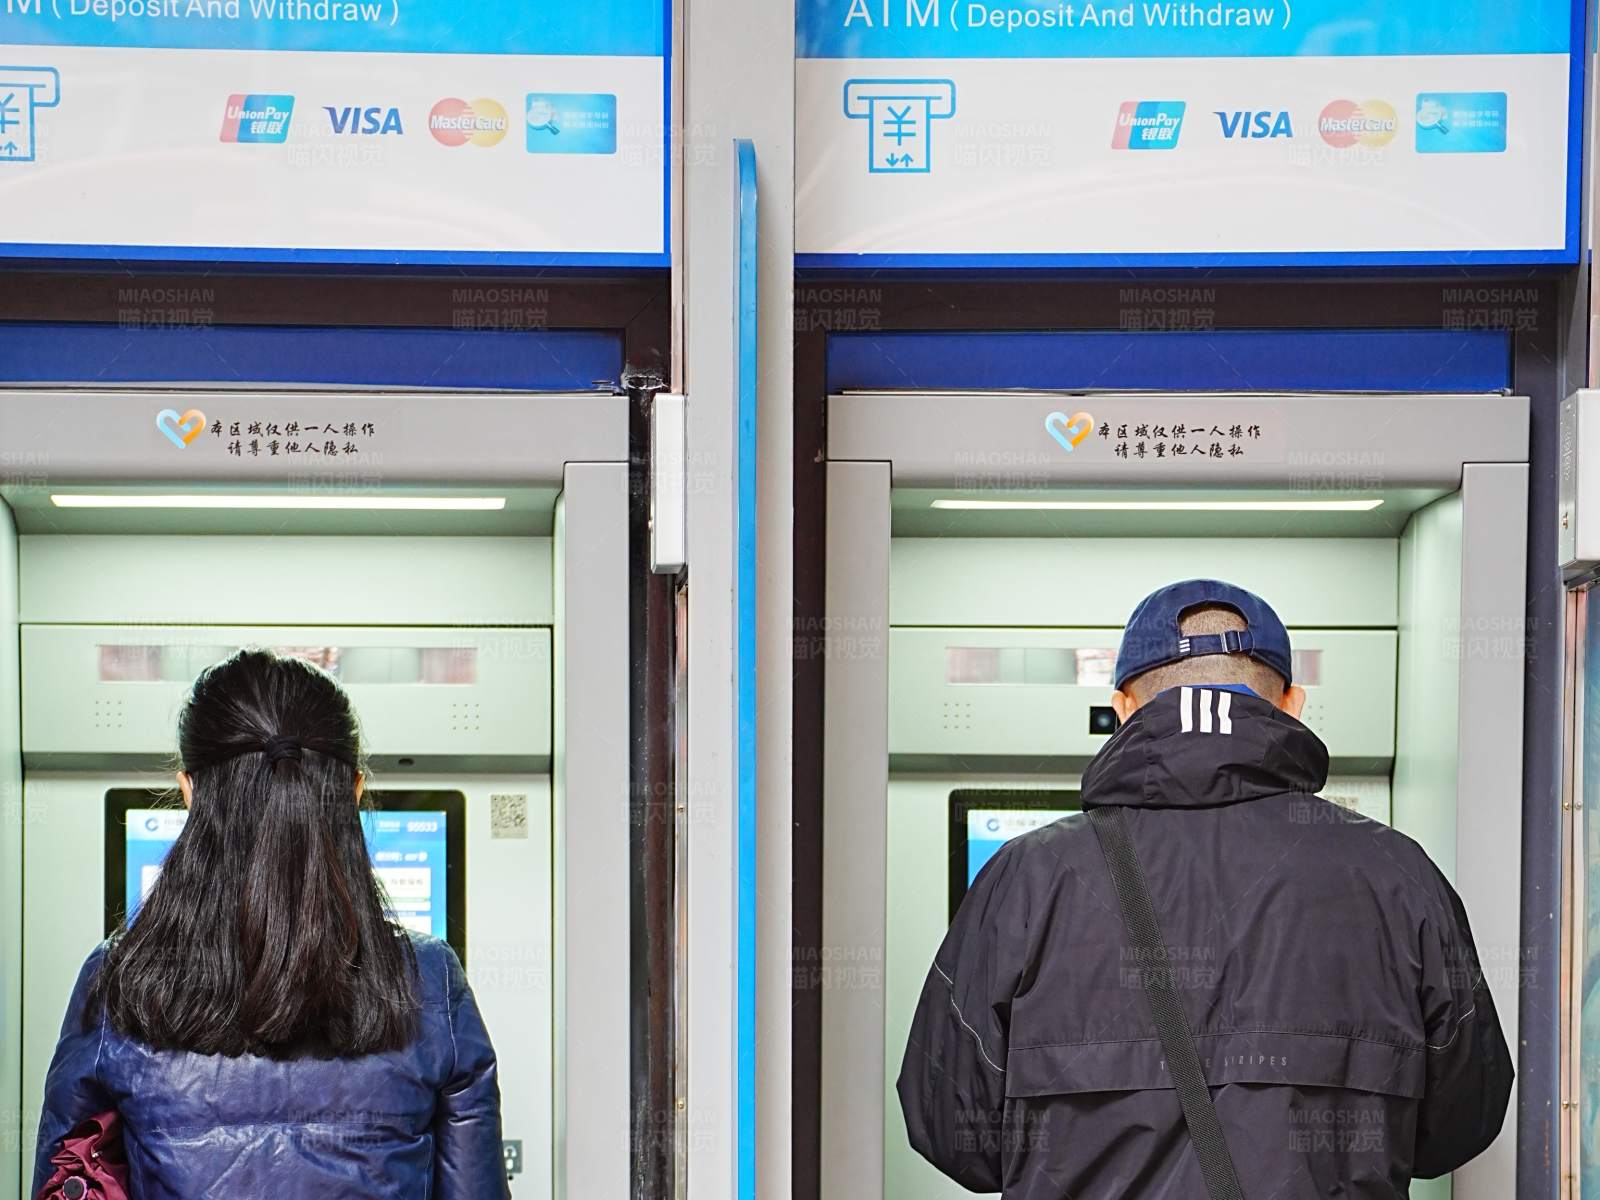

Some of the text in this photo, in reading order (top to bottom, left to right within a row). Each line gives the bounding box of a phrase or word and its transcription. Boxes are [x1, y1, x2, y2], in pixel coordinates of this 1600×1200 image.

[186, 0, 240, 18] And
[1080, 3, 1134, 27] And
[227, 106, 289, 125] UnionPay
[322, 106, 403, 135] VISA
[430, 114, 506, 131] MasterCard
[1119, 112, 1181, 131] UnionPay
[1320, 116, 1396, 133] MasterCard
[1213, 111, 1293, 139] VISA
[210, 420, 375, 438] 本区域仅供一人操作
[1098, 422, 1262, 440] 本区域仅供一人操作
[227, 439, 359, 457] 请尊重他人隐私
[1114, 441, 1244, 459] 请尊重他人隐私
